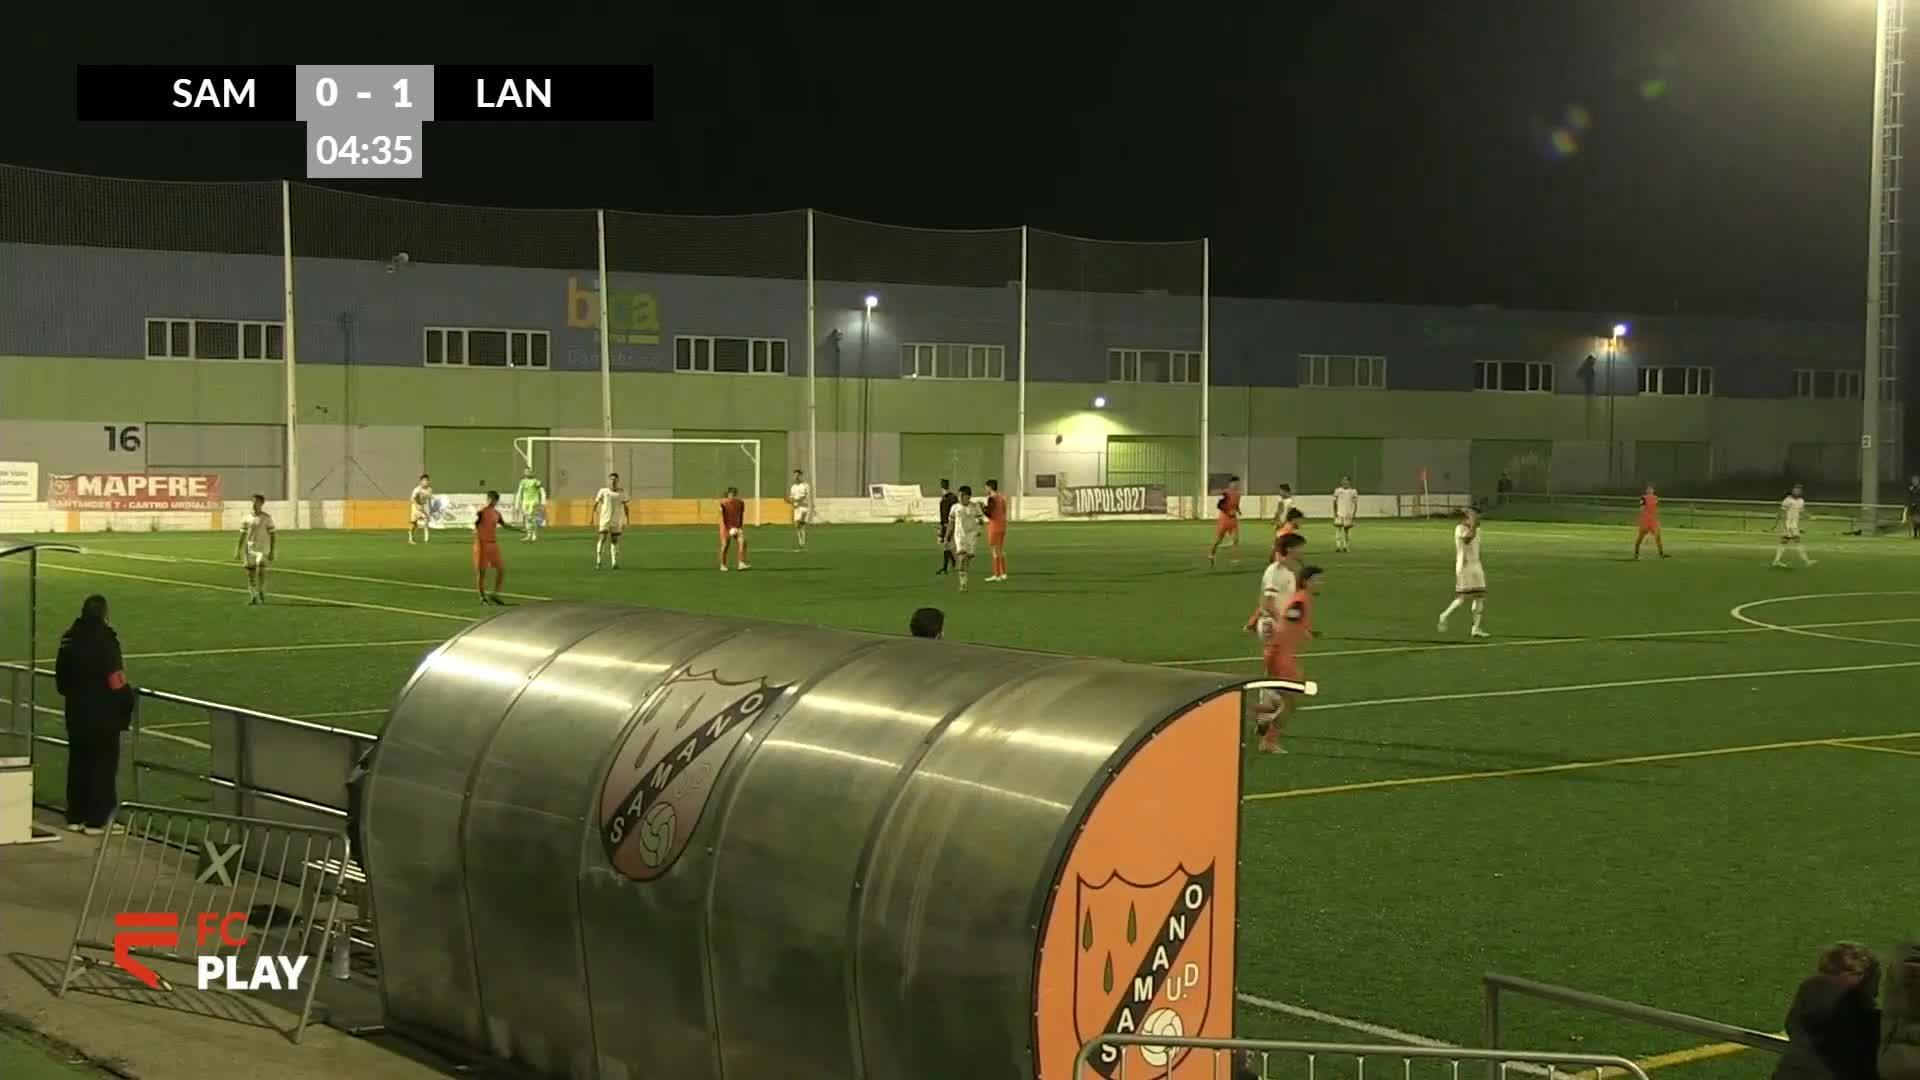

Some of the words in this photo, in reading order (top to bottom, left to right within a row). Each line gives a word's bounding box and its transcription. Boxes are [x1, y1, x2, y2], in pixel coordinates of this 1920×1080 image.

[104, 425, 141, 452] 16
[77, 475, 209, 497] MAPFRE
[1075, 487, 1146, 513] IMPULSO27
[610, 693, 764, 843] SAMANO
[1101, 884, 1203, 1062] SAMANO
